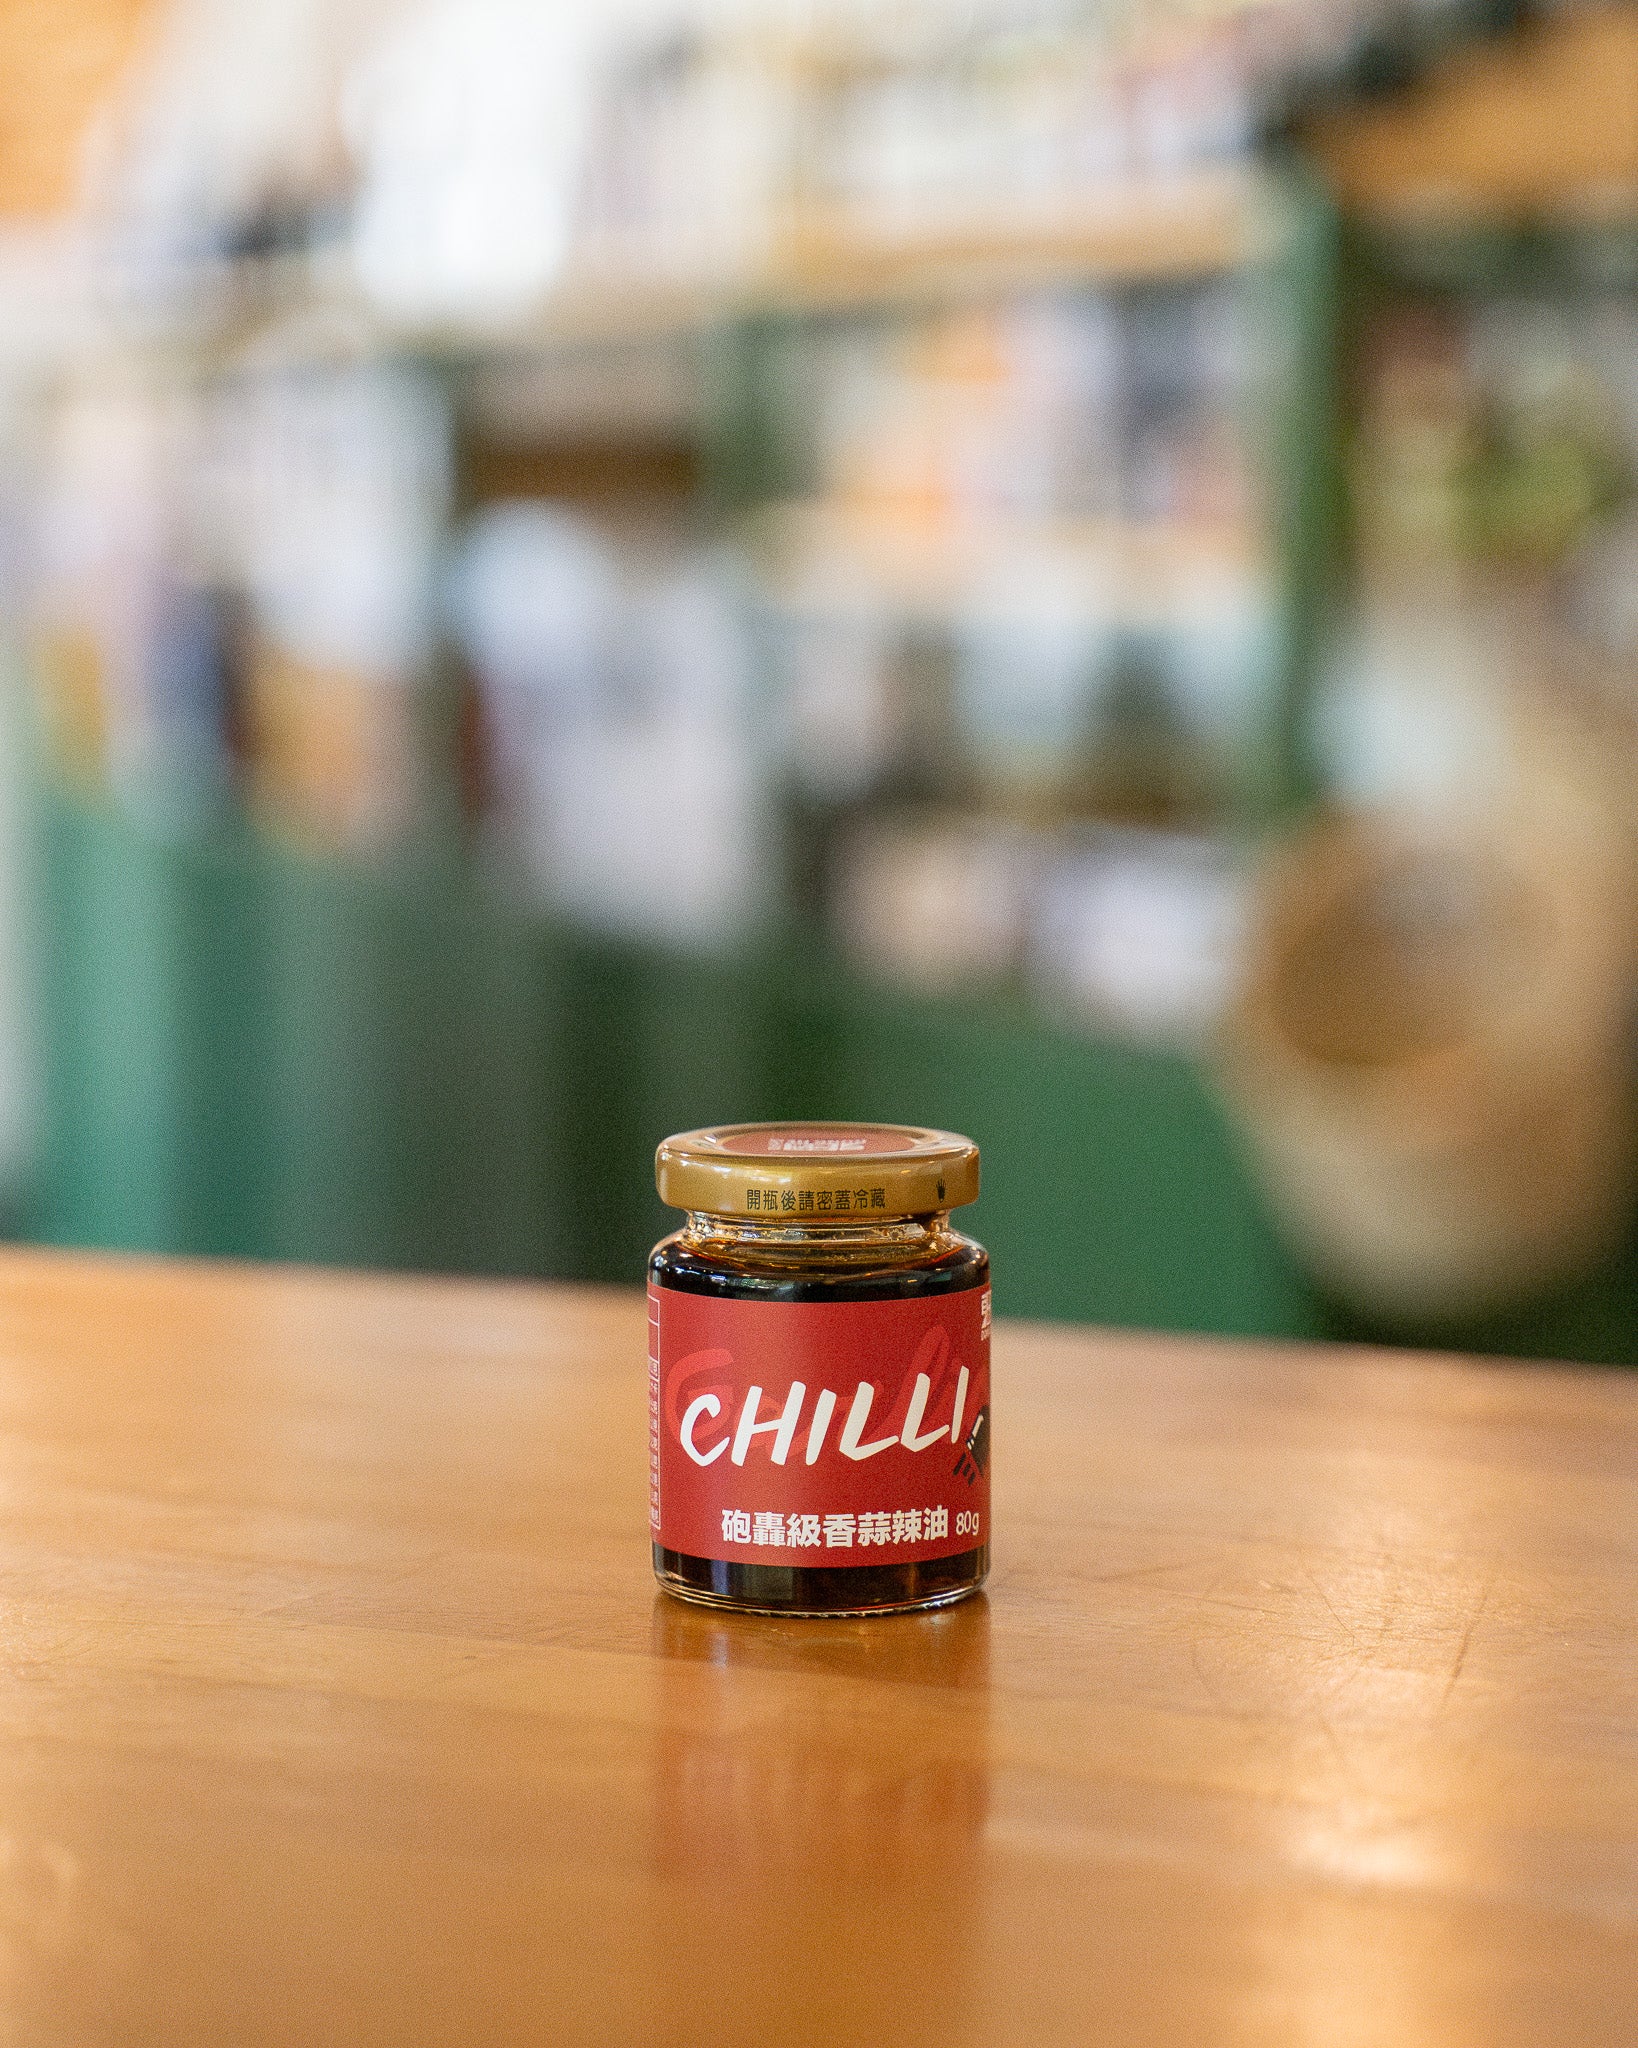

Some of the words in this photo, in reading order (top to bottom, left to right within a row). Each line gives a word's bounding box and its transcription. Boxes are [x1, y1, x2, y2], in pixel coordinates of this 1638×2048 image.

[746, 1187, 886, 1212] 開瓶後請密蓋冷藏
[680, 1365, 970, 1467] CHILLI
[721, 1504, 948, 1548] 砲轟級香蒜辣油
[955, 1511, 980, 1536] 80g
